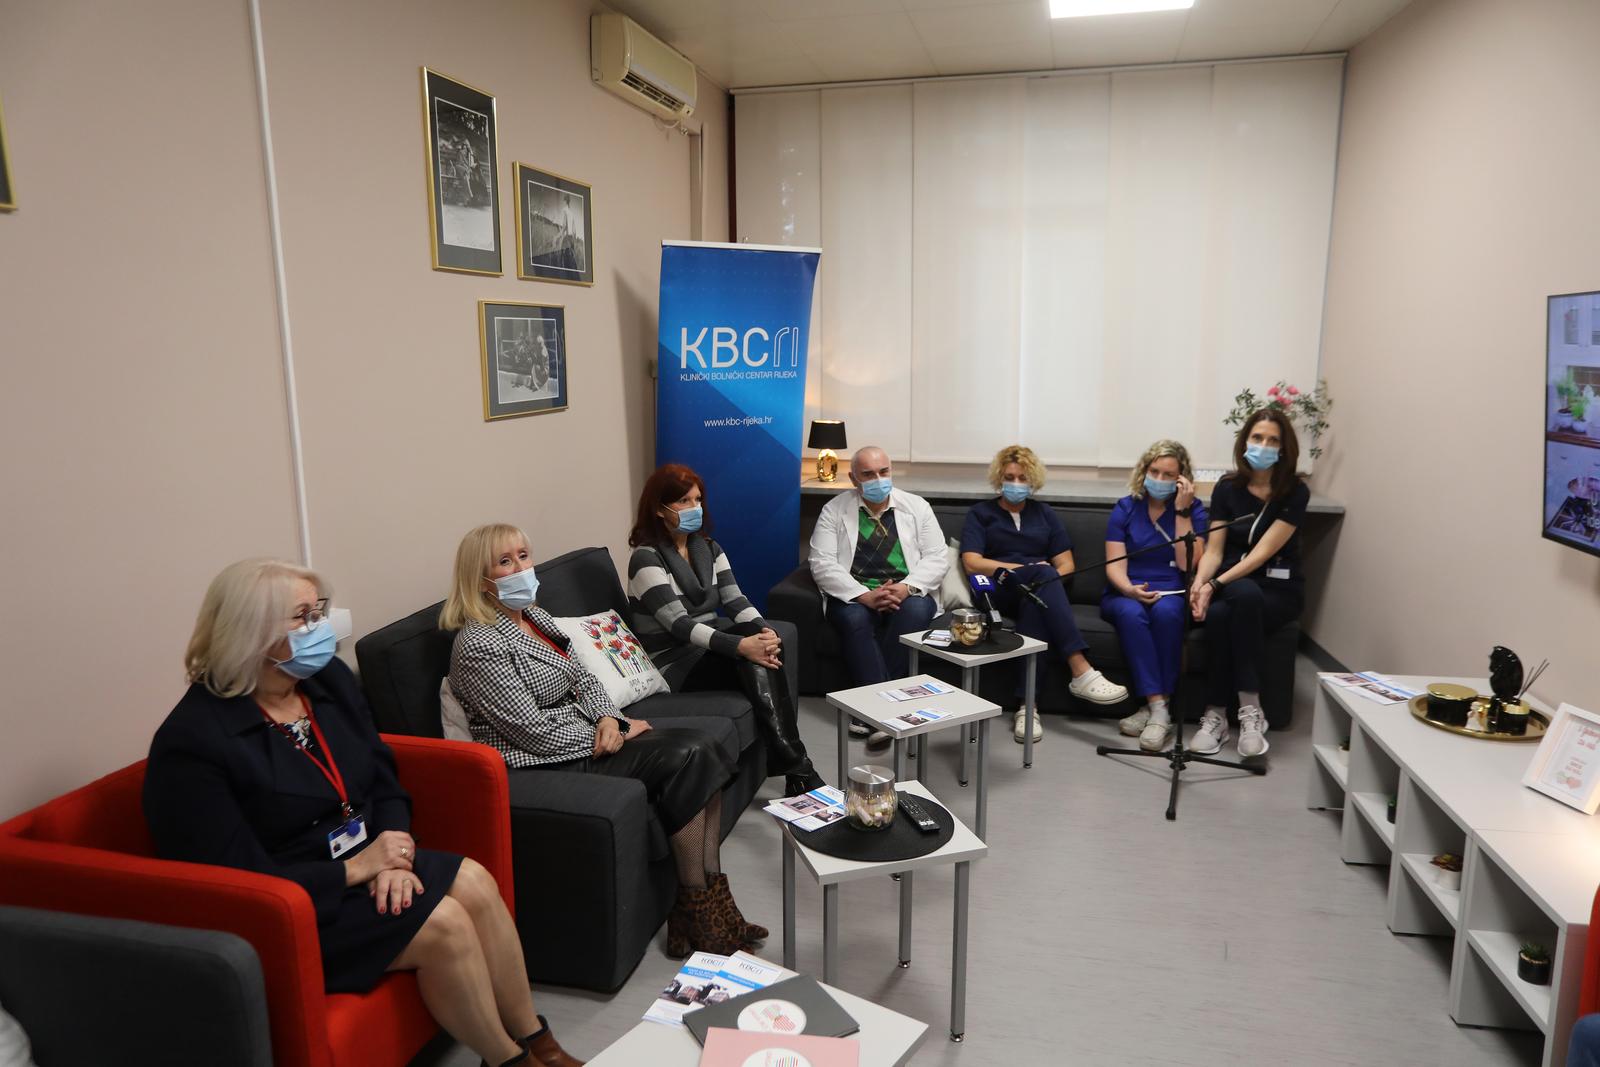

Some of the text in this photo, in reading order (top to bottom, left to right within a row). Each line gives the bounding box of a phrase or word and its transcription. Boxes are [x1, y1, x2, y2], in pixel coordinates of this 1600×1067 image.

[680, 370, 798, 382] KLINIČKI BOLNIČKI CENTAR RIJEKA
[704, 415, 773, 428] www.kbc-rijeka.hr
